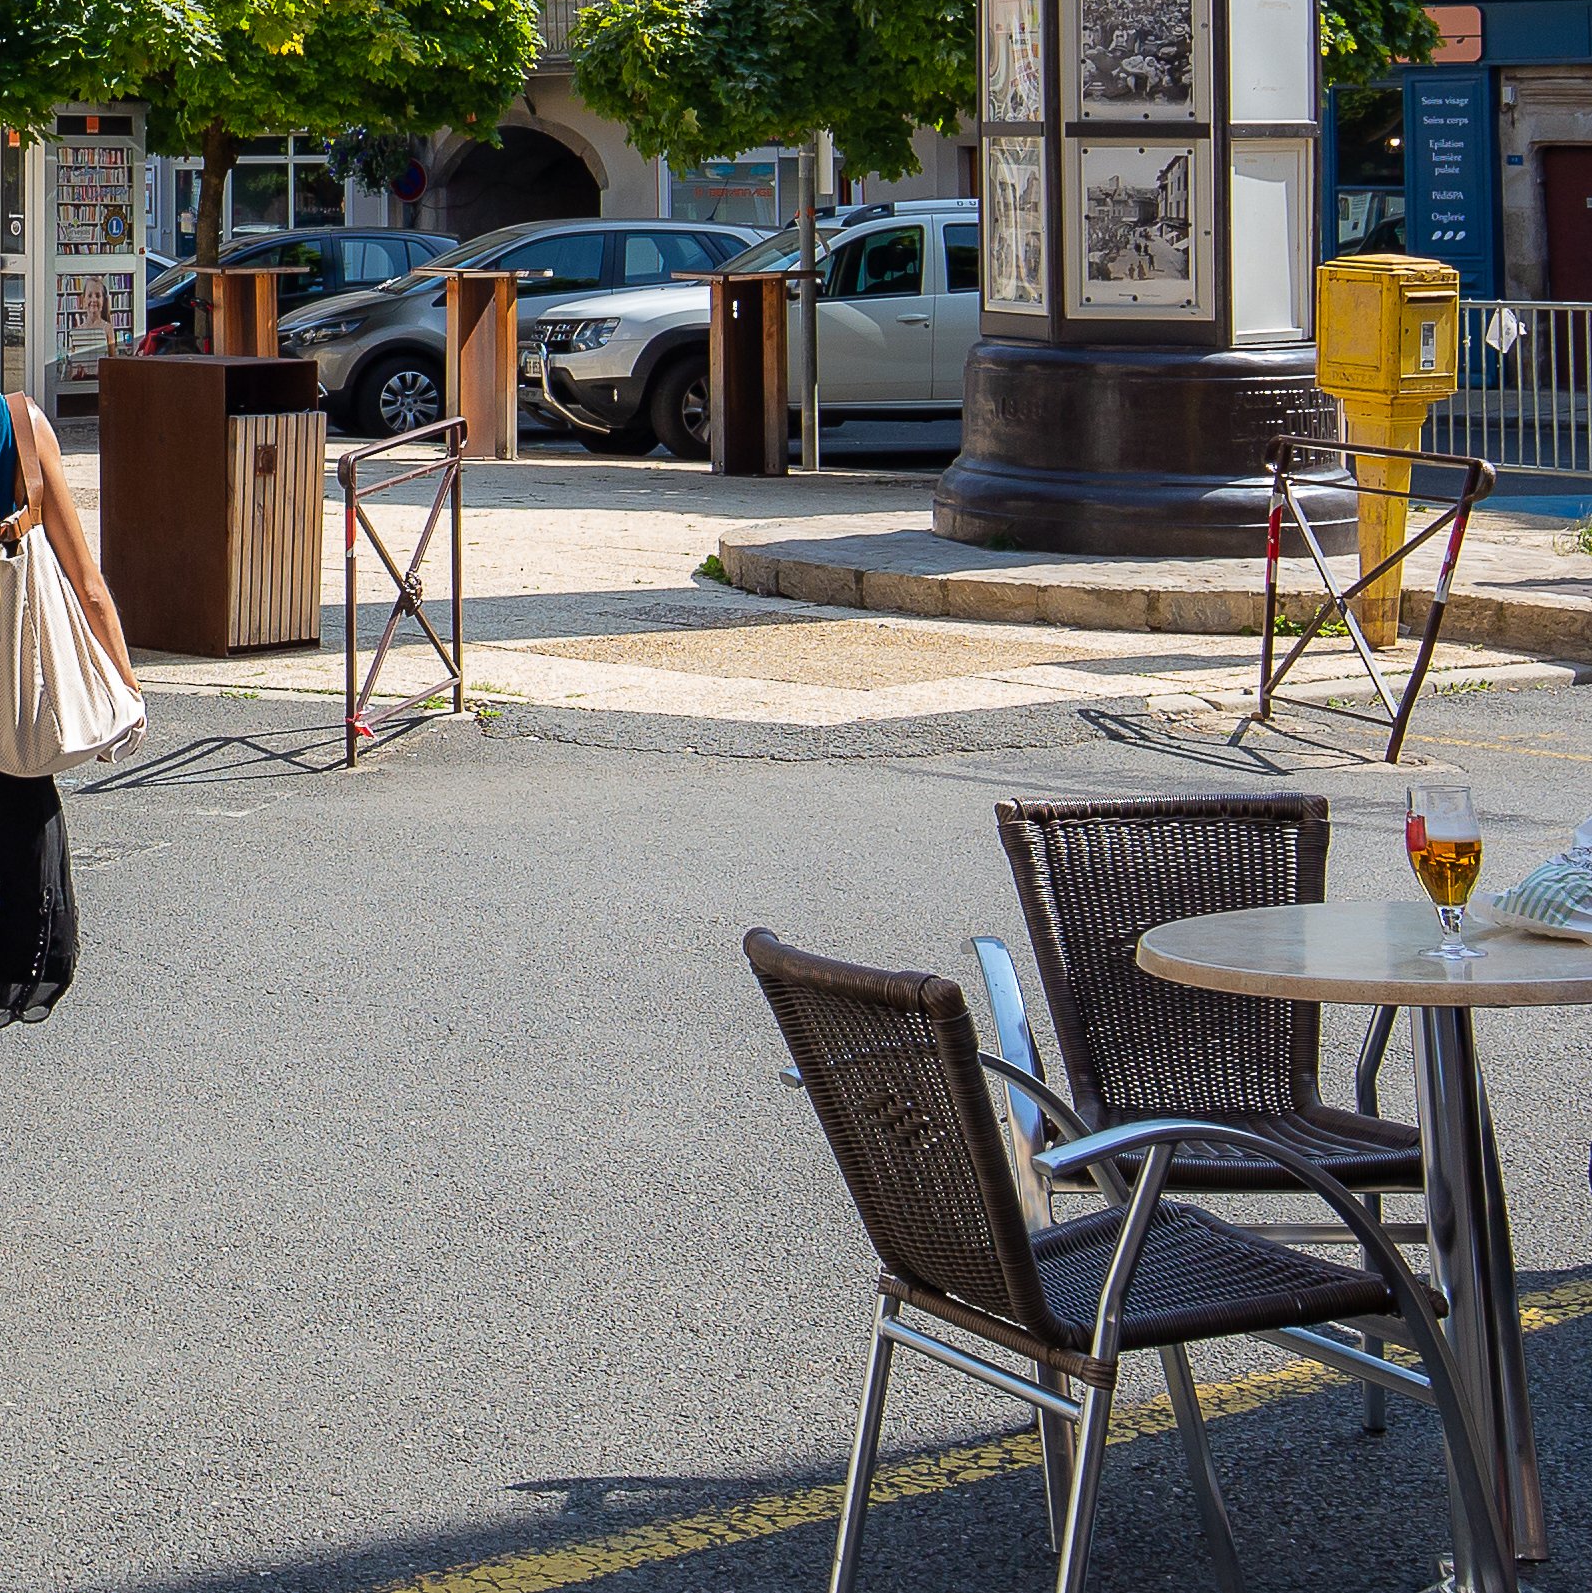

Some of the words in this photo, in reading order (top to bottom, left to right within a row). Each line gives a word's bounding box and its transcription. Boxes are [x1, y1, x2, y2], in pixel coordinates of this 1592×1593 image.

[1421, 96, 1443, 105] Soins
[1445, 96, 1469, 108] visage
[1423, 116, 1444, 125] Soins
[1447, 118, 1469, 127] corps
[1429, 139, 1464, 150] Epilation
[1432, 152, 1462, 162] lumière
[1435, 164, 1460, 176] pulsée
[1432, 191, 1464, 200] PédiSPA
[1431, 213, 1465, 223] Onglerie
[112, 220, 119, 233] L
